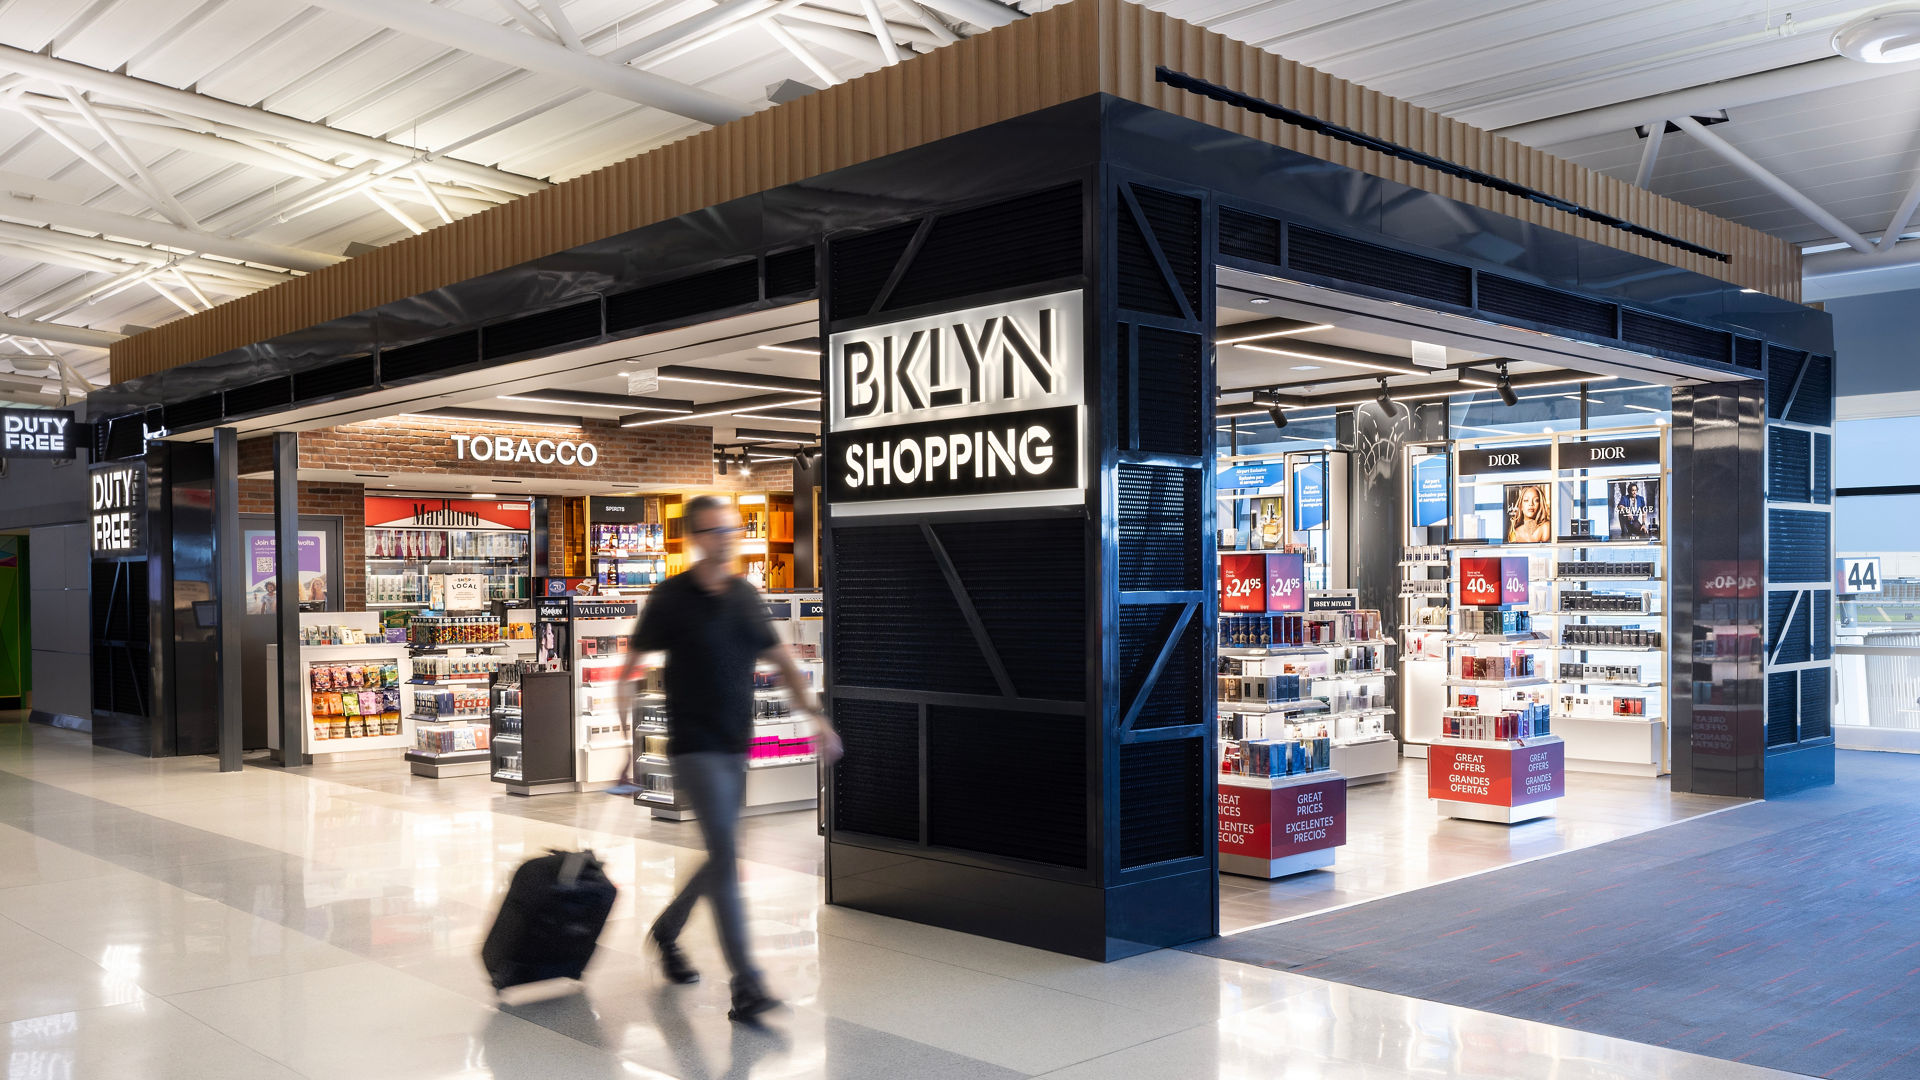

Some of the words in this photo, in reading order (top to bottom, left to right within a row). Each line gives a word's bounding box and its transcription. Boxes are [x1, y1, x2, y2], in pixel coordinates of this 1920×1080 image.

[843, 308, 1057, 418] BKLYN
[5, 416, 68, 433] DUTY
[5, 434, 65, 450] FREE
[451, 434, 598, 467] TOBACCO
[845, 425, 1053, 488] SHOPPING
[1591, 446, 1626, 460] DIOR
[1488, 453, 1521, 467] DIOR
[93, 469, 132, 510] DUTY
[413, 499, 479, 527] Marlboro
[1614, 505, 1654, 514] SAUVAGE
[94, 512, 130, 551] FREE
[1847, 562, 1877, 591] 44
[1466, 577, 1495, 593] 40%
[1506, 577, 1525, 593] 40%
[579, 606, 626, 615] VALENTINO
[1455, 753, 1484, 764] GREAT
[1529, 752, 1548, 762] GREAT
[1453, 762, 1486, 773] OFFERS
[1528, 761, 1549, 772] OFFERS
[1449, 774, 1490, 786] GRANDES
[1525, 773, 1552, 785] GRANDES
[1450, 784, 1488, 795] OFERTAS
[1526, 783, 1551, 795] OFERTAS
[1218, 793, 1240, 805] REAT
[1297, 791, 1323, 804] GREAT
[1218, 805, 1241, 817] RICES
[1297, 802, 1324, 816] PRICES
[1219, 820, 1255, 835] LENTES
[1285, 816, 1334, 834] EXCELENTES
[1218, 832, 1245, 845] ECIOS
[1294, 828, 1326, 844] PRECIOS
